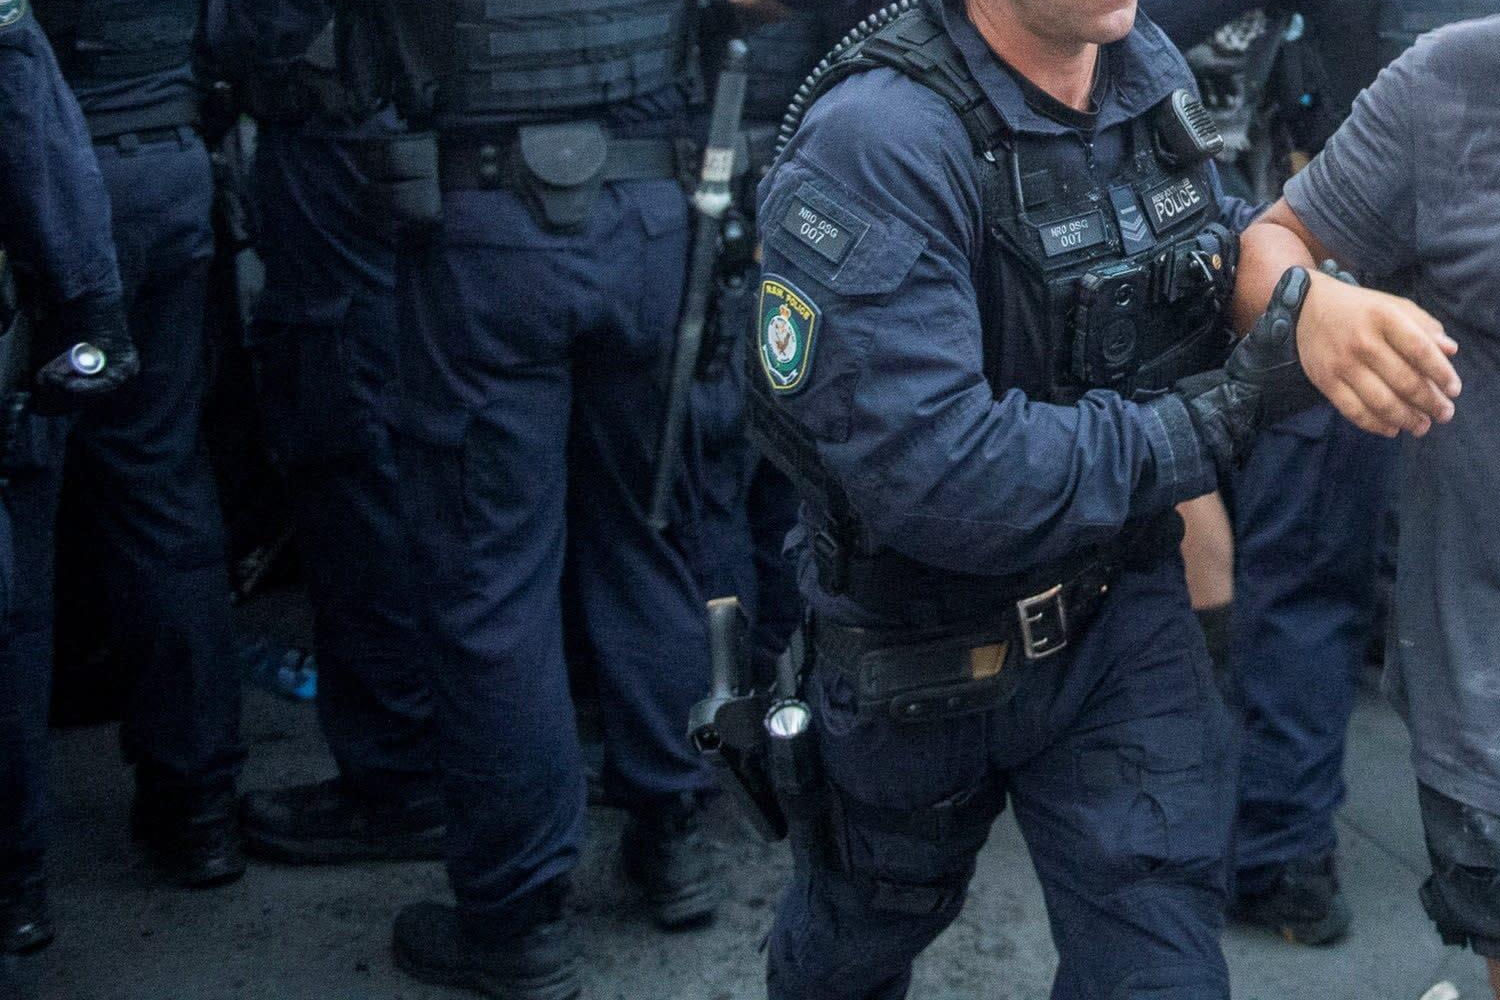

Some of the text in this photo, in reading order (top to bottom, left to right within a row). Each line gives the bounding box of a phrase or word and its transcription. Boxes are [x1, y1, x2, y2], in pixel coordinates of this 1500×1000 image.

[1154, 184, 1200, 223] POLICE
[800, 222, 825, 244] 007
[1061, 231, 1081, 247] 007
